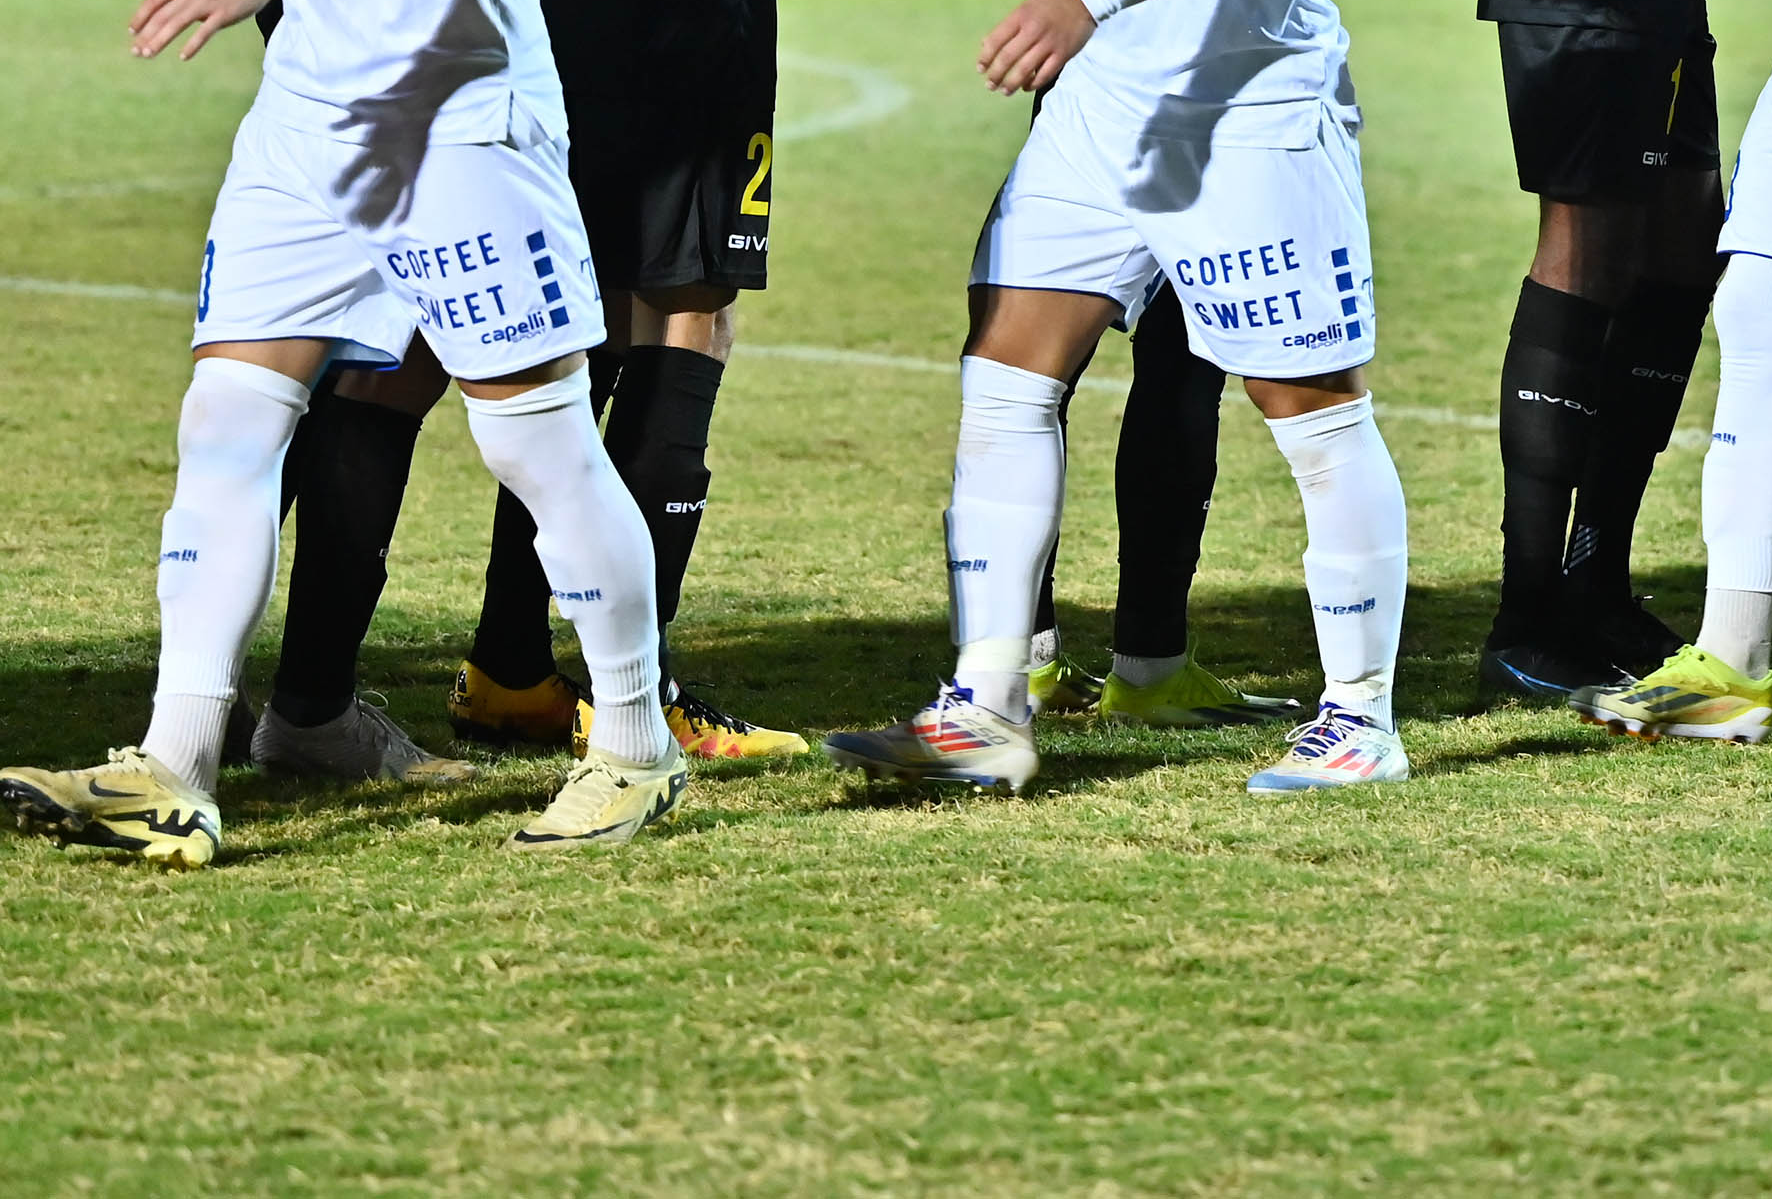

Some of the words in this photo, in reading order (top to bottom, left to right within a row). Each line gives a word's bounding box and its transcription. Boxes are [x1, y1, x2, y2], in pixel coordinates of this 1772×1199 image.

[740, 132, 773, 216] 2
[386, 232, 501, 280] COFFEE
[1175, 237, 1301, 287] COFFEE
[416, 284, 507, 330] SWEET
[480, 310, 546, 345] capelli
[1194, 289, 1303, 330] SWEET
[1282, 322, 1344, 349] capelli
